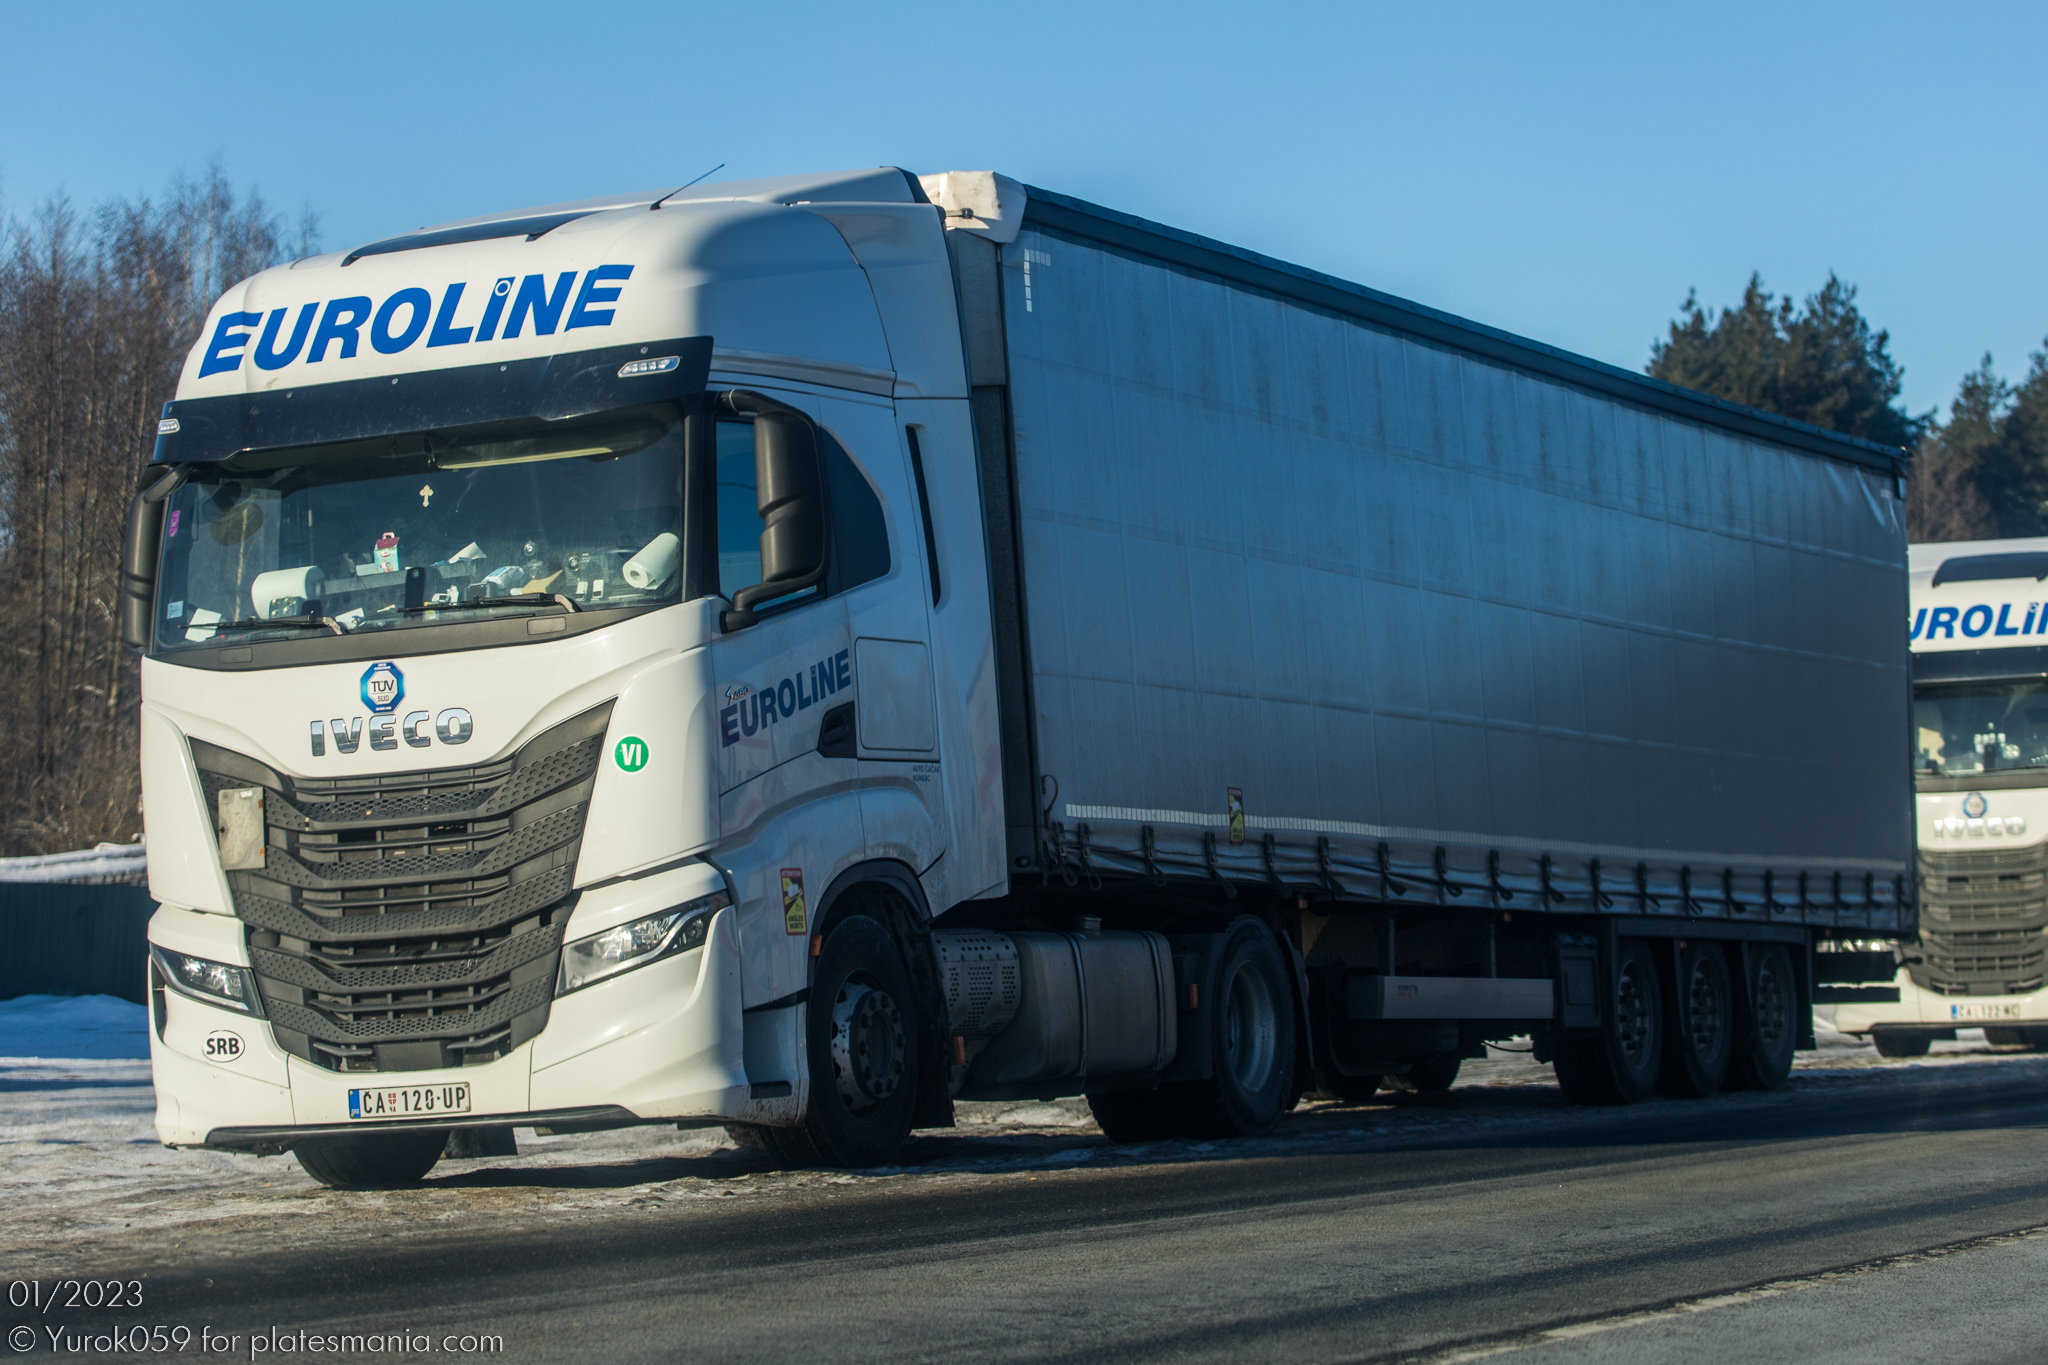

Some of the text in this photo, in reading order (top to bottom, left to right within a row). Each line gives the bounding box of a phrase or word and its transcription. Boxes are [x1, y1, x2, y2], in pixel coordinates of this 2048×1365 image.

[198, 264, 635, 379] EUROLINE
[371, 680, 394, 692] TÜV
[720, 648, 851, 748] EUROLINE
[310, 707, 473, 756] IVECO
[620, 743, 641, 766] VI
[1934, 816, 2026, 837] IVECO
[790, 922, 803, 930] MORTS
[206, 1037, 240, 1055] SRB
[363, 1091, 385, 1113] ČA
